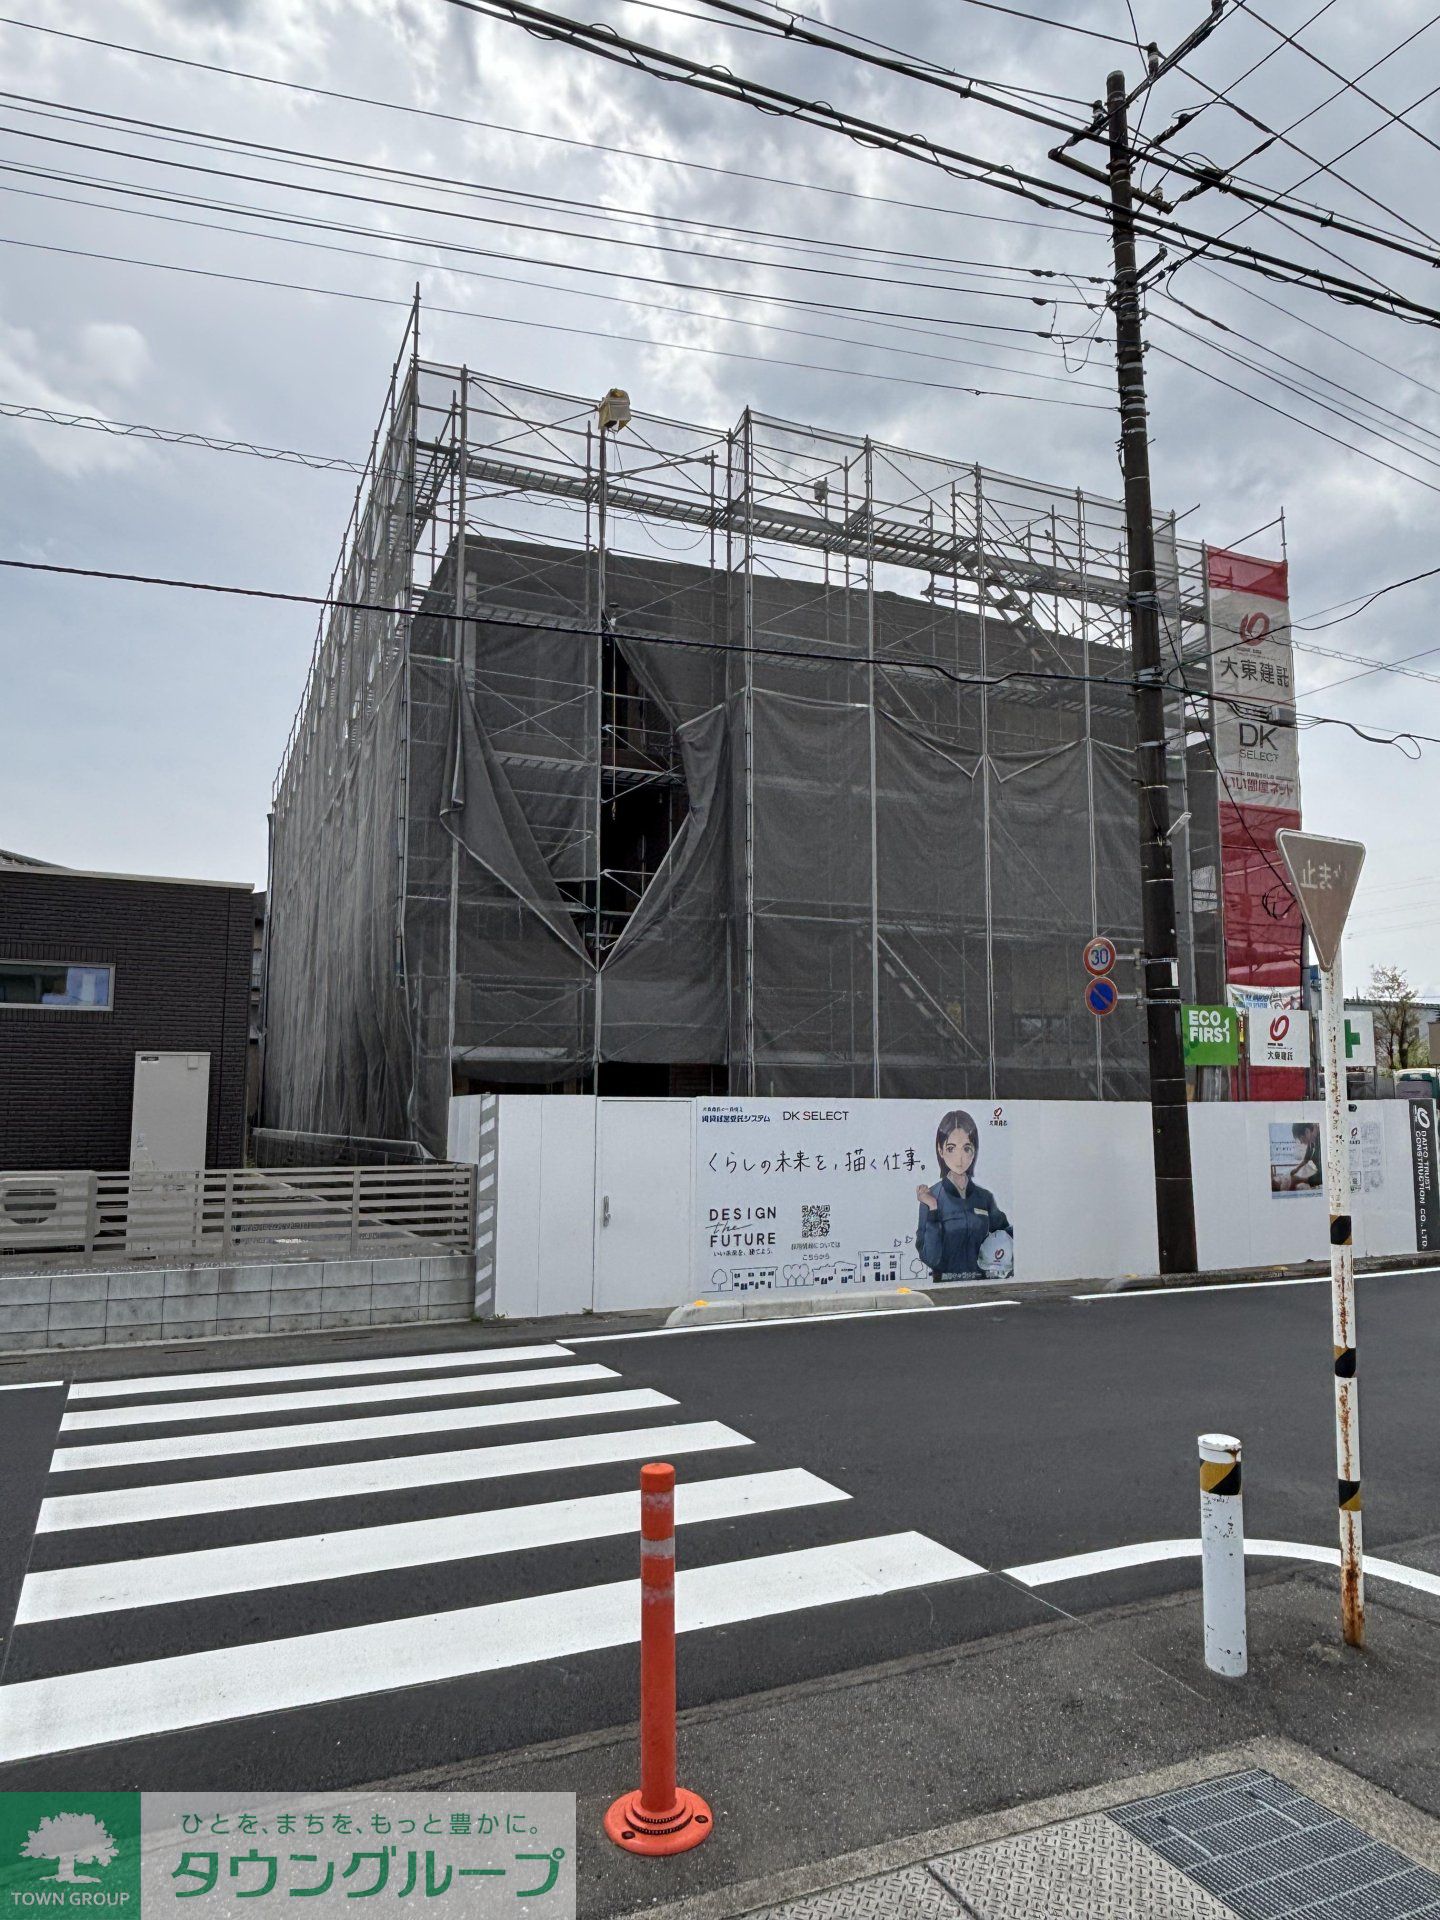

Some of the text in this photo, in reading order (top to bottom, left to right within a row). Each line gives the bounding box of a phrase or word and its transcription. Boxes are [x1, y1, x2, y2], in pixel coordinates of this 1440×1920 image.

[1220, 657, 1289, 688] 大東建託
[1239, 722, 1279, 751] DK
[1240, 748, 1279, 762] SELECT
[1090, 948, 1109, 966] 30
[1189, 1010, 1221, 1026] ECO
[1190, 1017, 1230, 1043] FIRST
[782, 1111, 849, 1121] DK SELECT
[1415, 1130, 1426, 1204] CONSTRUCTION
[1421, 1130, 1431, 1190] DAITO TRUST
[709, 1206, 776, 1220] DESIGN
[710, 1232, 776, 1247] FUTURE
